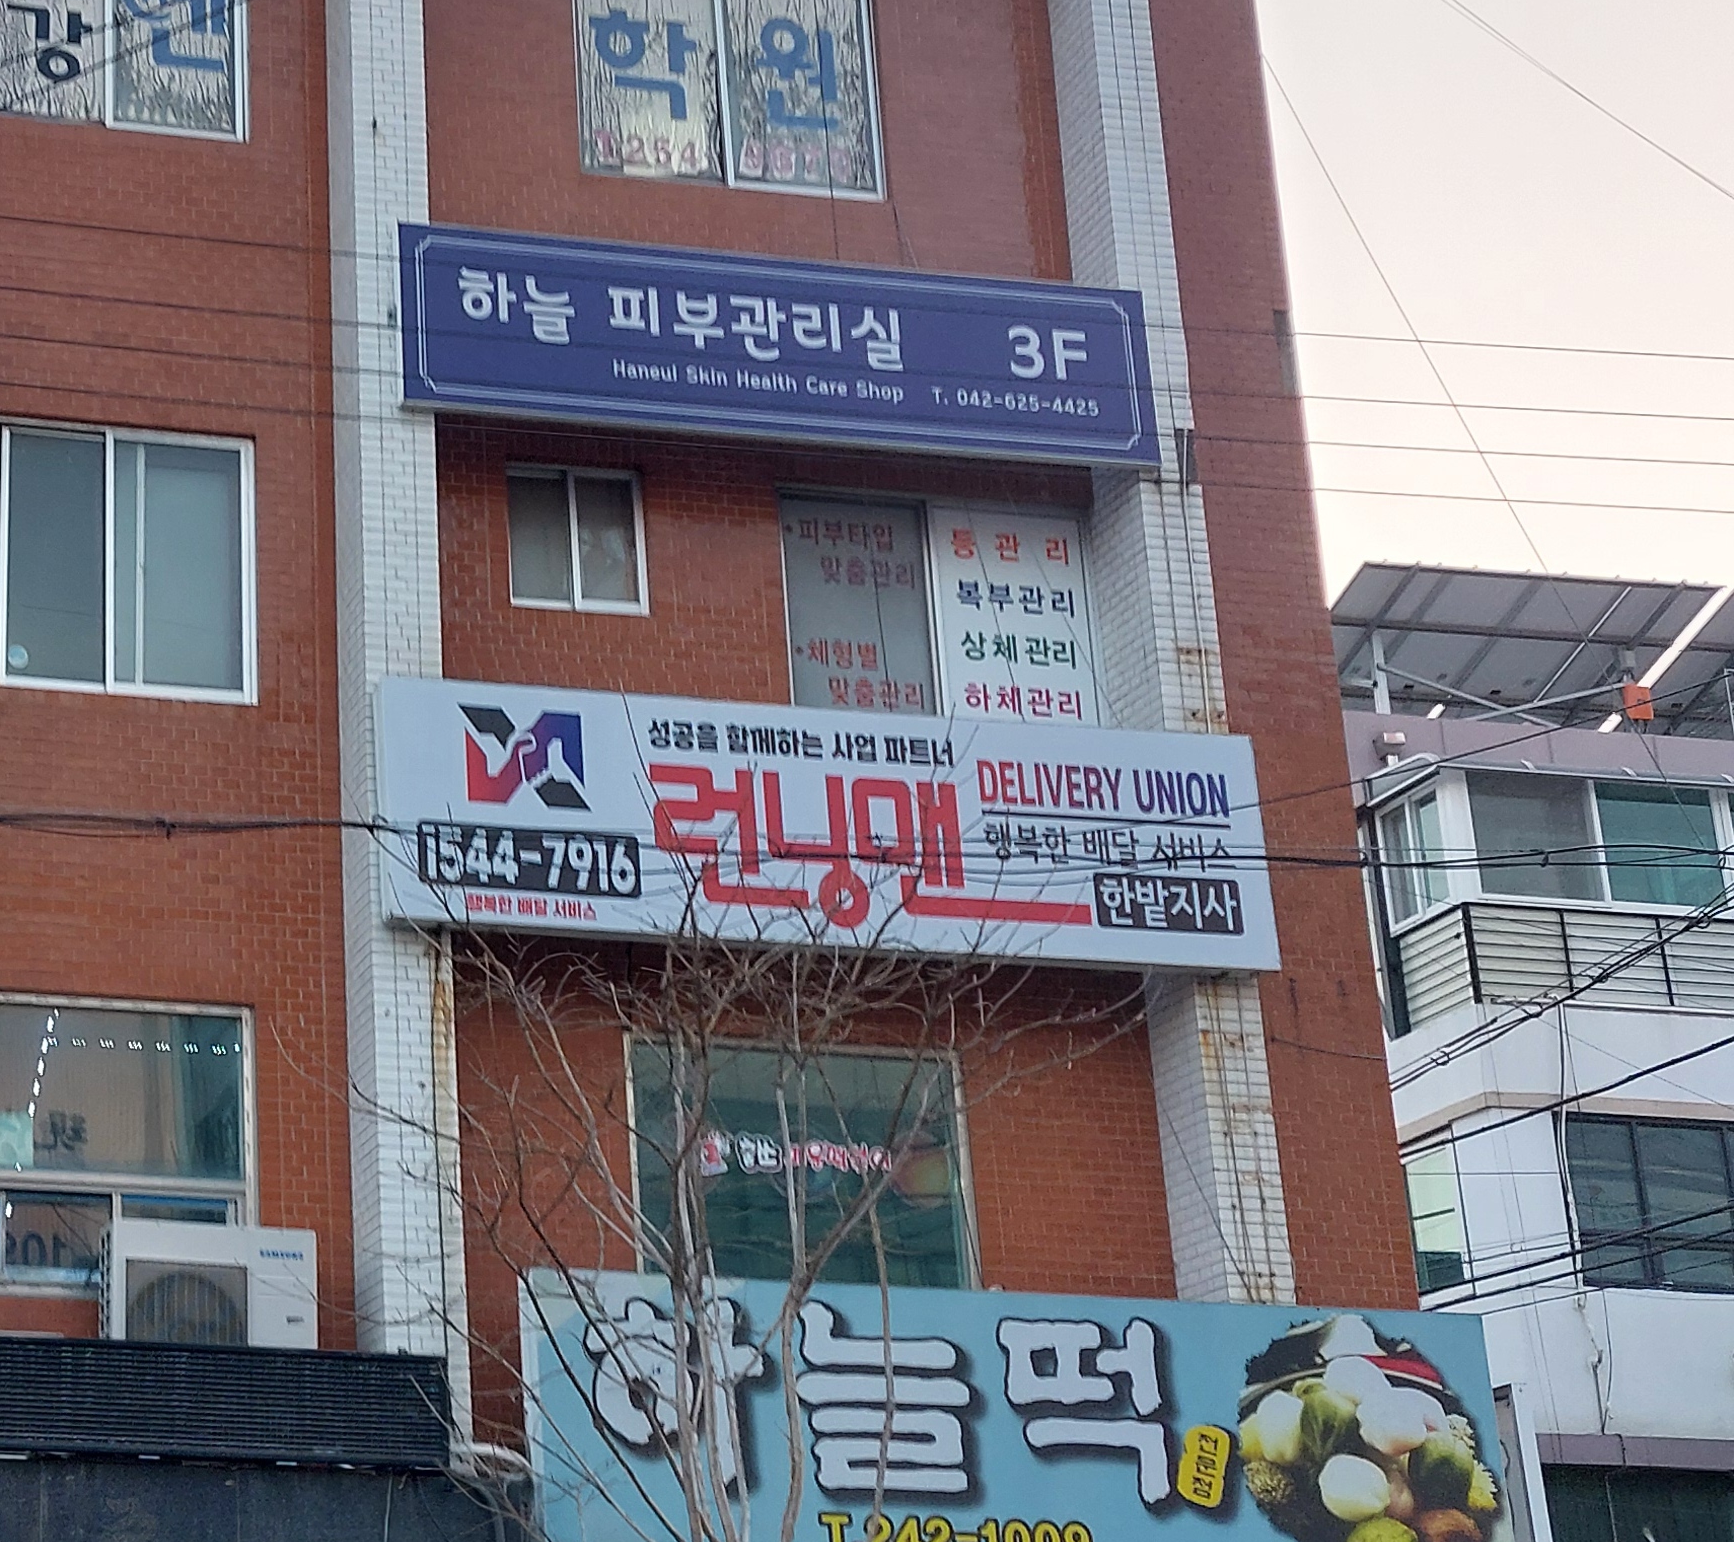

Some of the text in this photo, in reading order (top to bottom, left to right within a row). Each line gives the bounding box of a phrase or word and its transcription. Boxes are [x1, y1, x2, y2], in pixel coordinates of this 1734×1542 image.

[457, 265, 905, 373] 하늘 피부관리실
[612, 358, 678, 383] Haneul
[686, 364, 728, 388] Skin
[736, 368, 798, 395] Health
[805, 375, 848, 399] Care
[855, 379, 905, 405] Shop
[1007, 324, 1088, 381] 3F
[956, 578, 1076, 619] 복부관리
[647, 717, 956, 768] 성공을 함께하는 사업 파트너
[976, 759, 1231, 818] DELIVERY UNION
[422, 823, 637, 896] 1544-7916
[649, 762, 1093, 928] 런닝맨
[983, 822, 1237, 873] 행복한 배달 서비스
[583, 1295, 1171, 1505] 하늘떡
